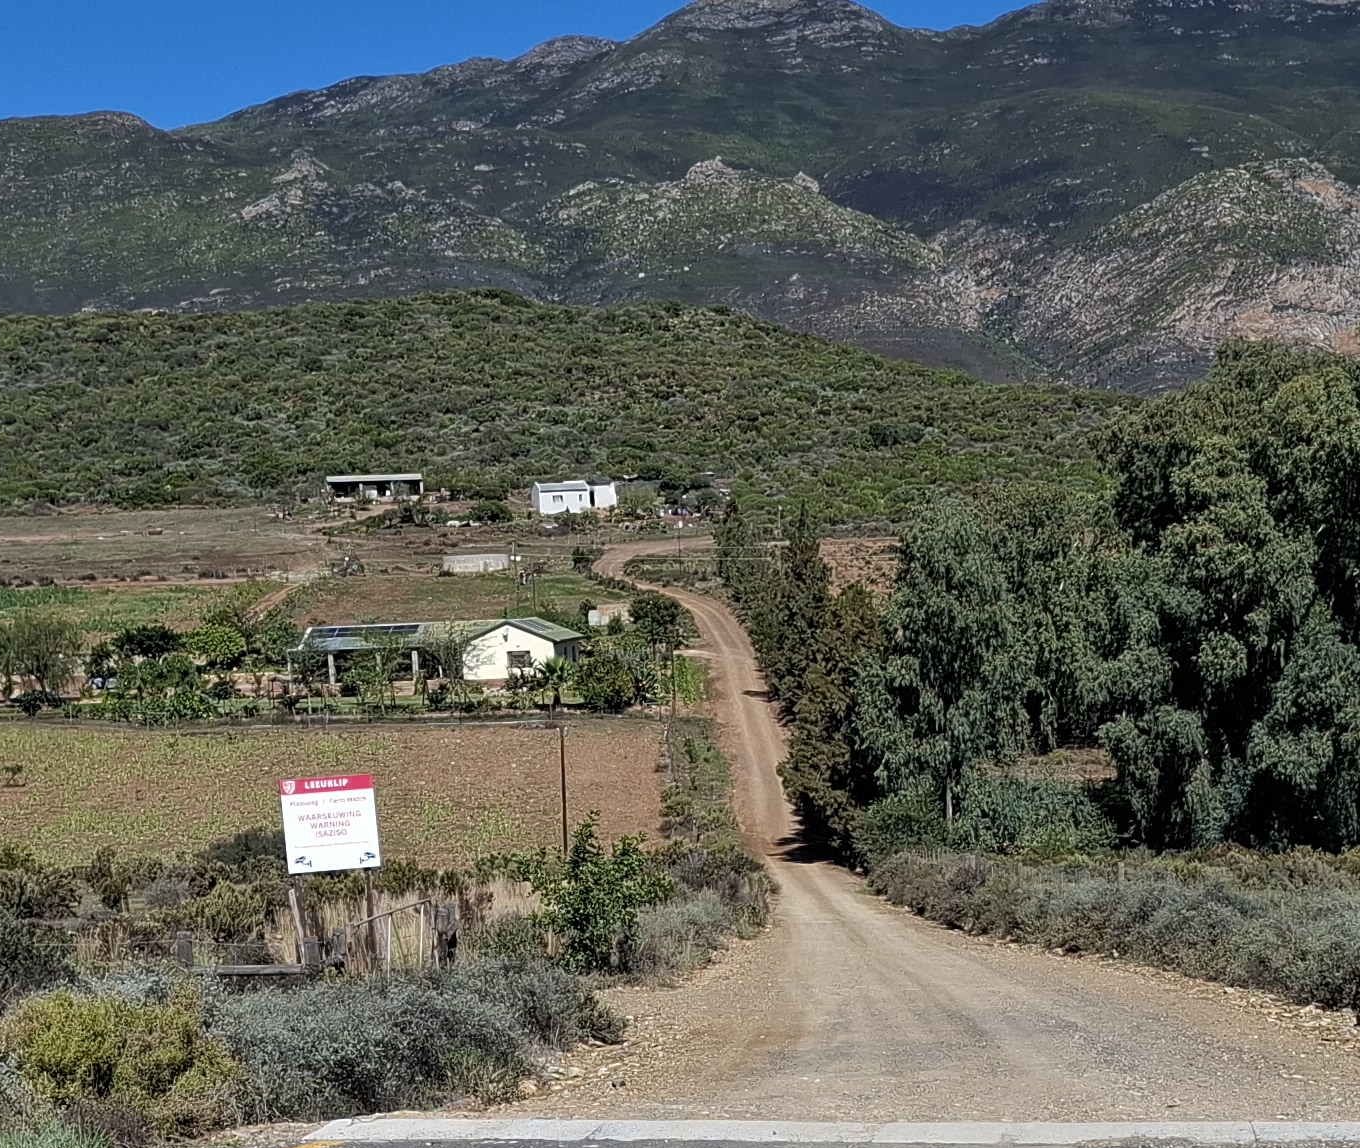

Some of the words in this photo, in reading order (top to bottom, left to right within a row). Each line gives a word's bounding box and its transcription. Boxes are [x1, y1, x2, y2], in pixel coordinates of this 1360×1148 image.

[304, 779, 348, 789] LEEUKLIP
[309, 819, 351, 829] WARNING
[316, 828, 348, 838] ISAZISO
